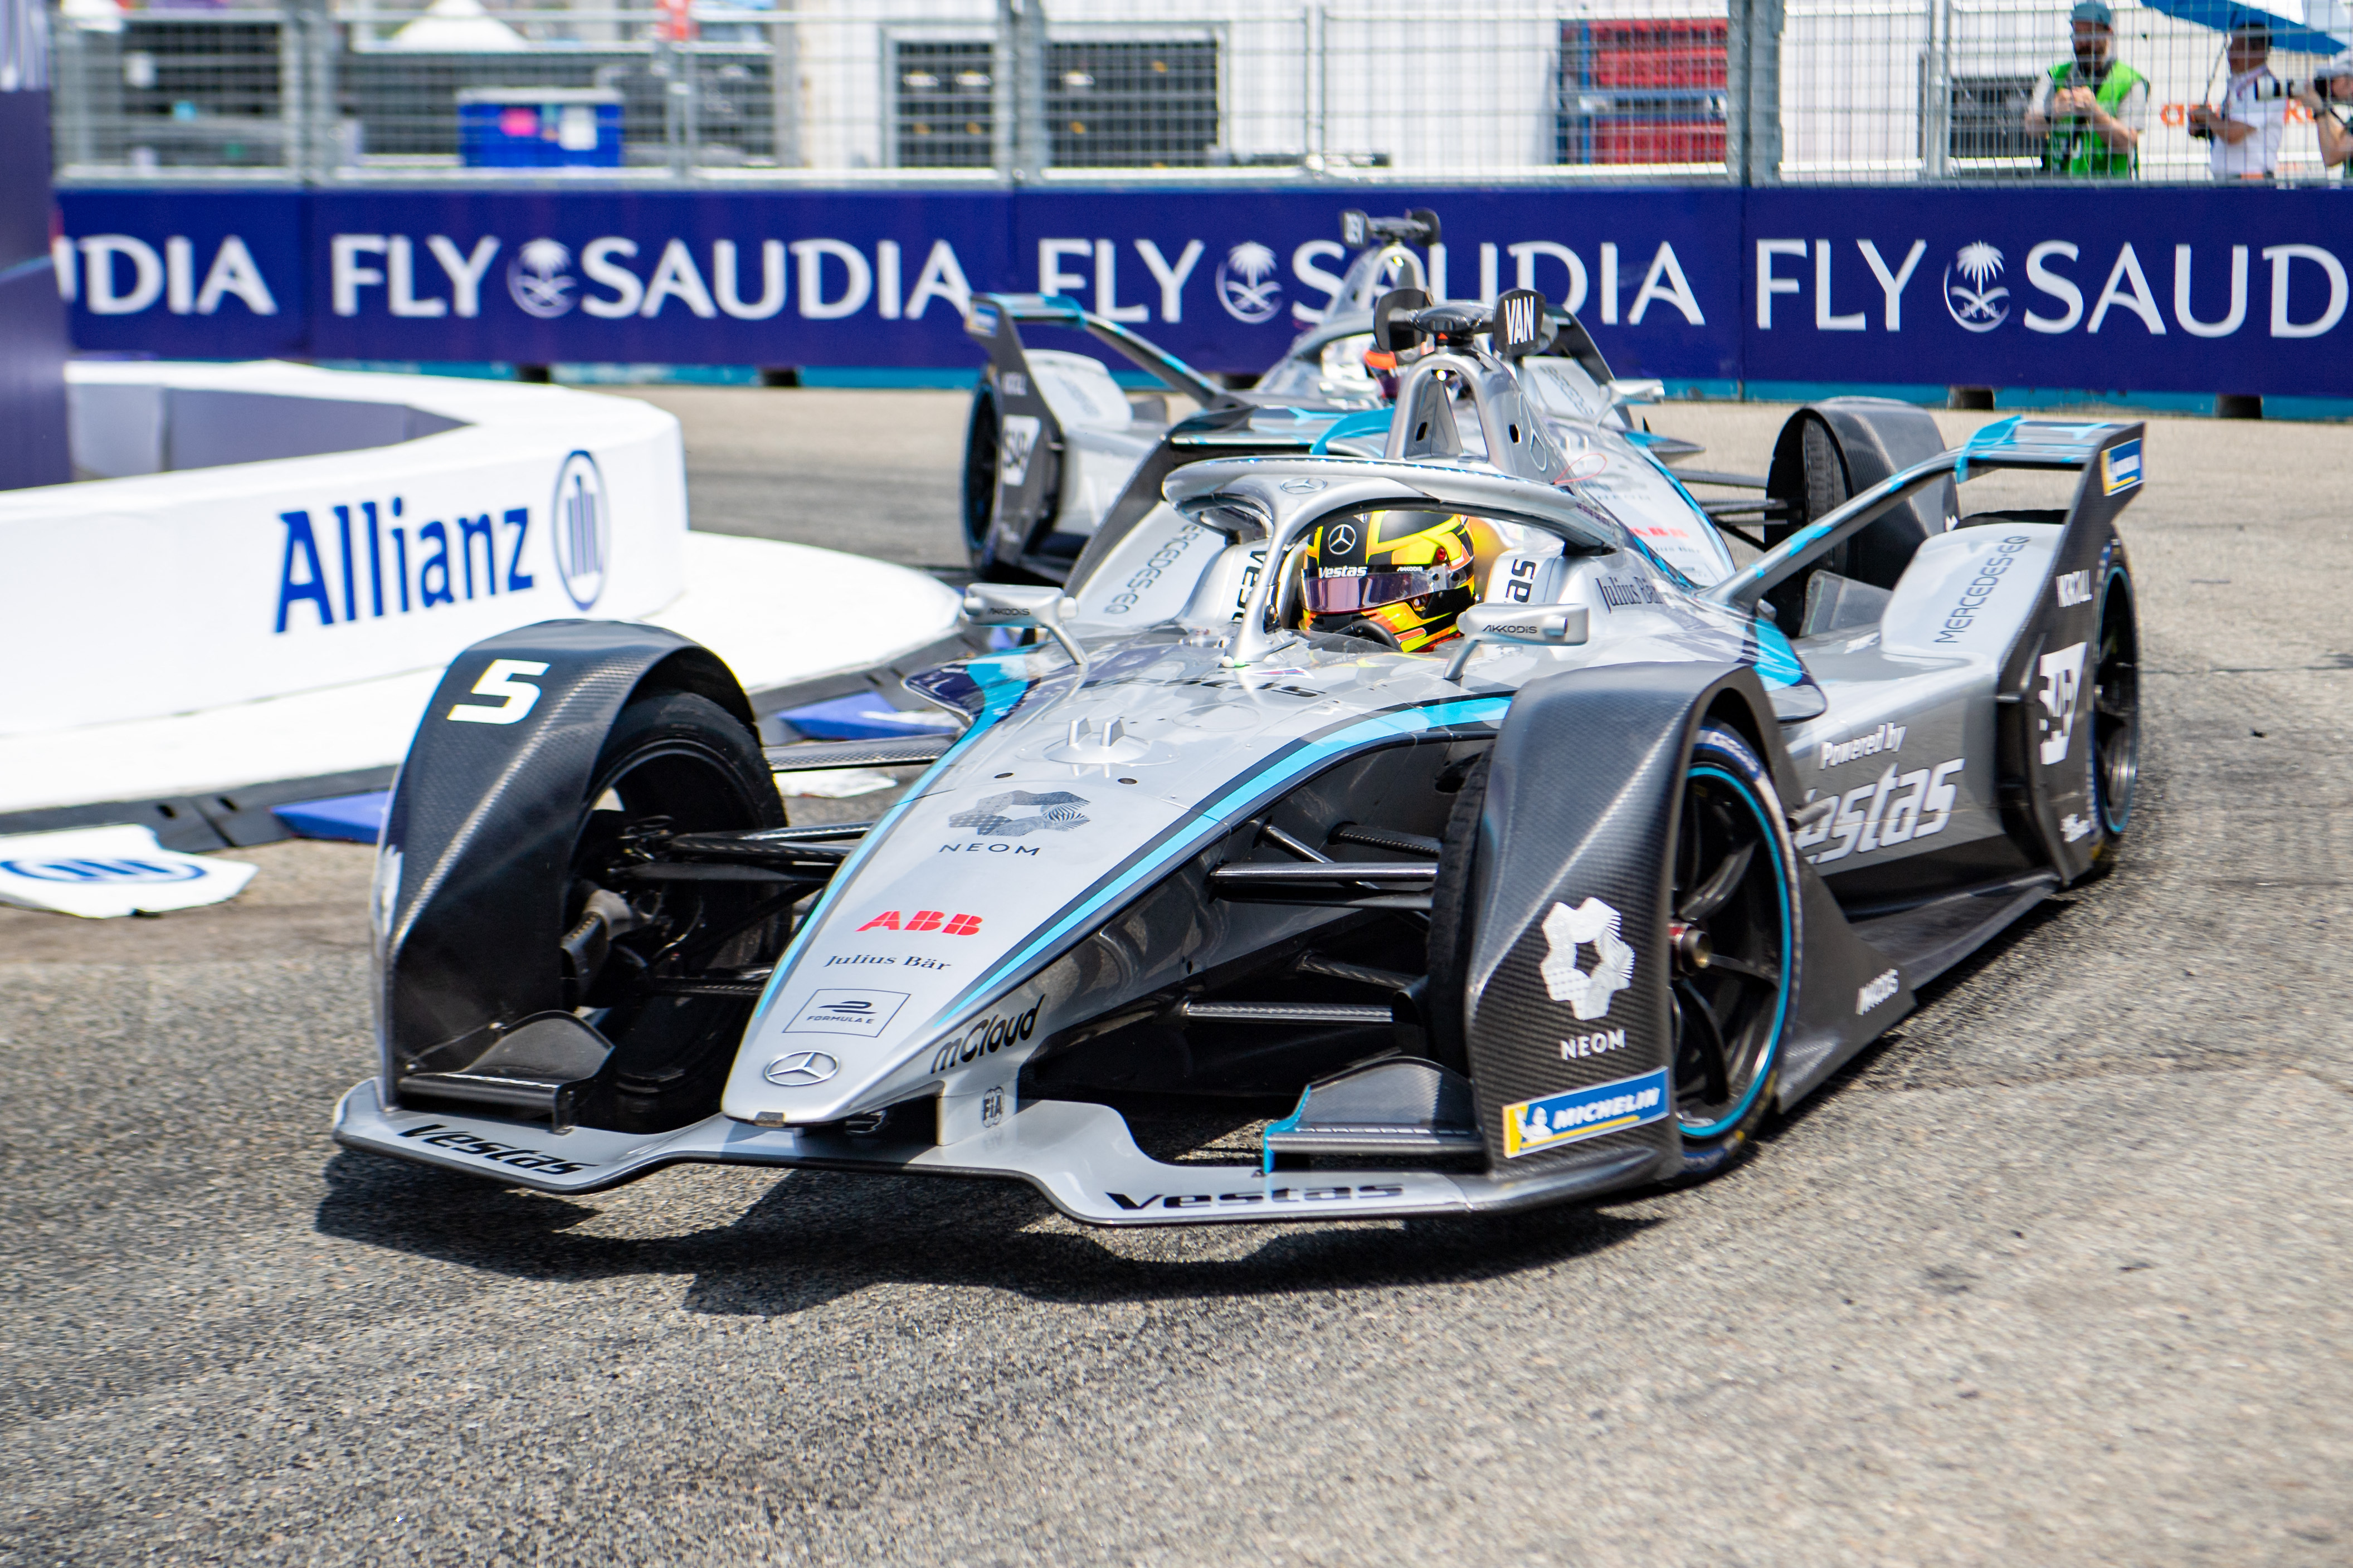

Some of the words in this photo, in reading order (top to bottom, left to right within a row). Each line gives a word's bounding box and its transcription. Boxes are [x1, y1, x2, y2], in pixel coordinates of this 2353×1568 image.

[332, 234, 501, 317] FLY
[580, 236, 973, 320] SAUDIA
[1038, 238, 1205, 324] FLY
[1757, 238, 1927, 333] FLY
[2024, 240, 2349, 338] SAUD
[1505, 295, 1534, 345] VAN
[273, 496, 534, 633] Allianz
[1102, 524, 1205, 614] ERCEDES-EQ
[1318, 565, 1368, 579] Vestas
[1933, 536, 2032, 643] MERCEDES-EQ
[1595, 577, 1642, 614] Julius
[447, 659, 551, 725] 5
[1819, 724, 1887, 770] Powered
[1794, 758, 1966, 864] estas
[939, 843, 1040, 856] NEOM
[855, 910, 983, 936] ABB
[824, 953, 897, 968] Julius
[902, 955, 952, 971] Bär
[930, 993, 1046, 1074] mCloud
[1552, 1087, 1661, 1130] MICHELIN
[398, 1124, 601, 1175] Vestas
[1105, 1183, 1404, 1210] Vestas
